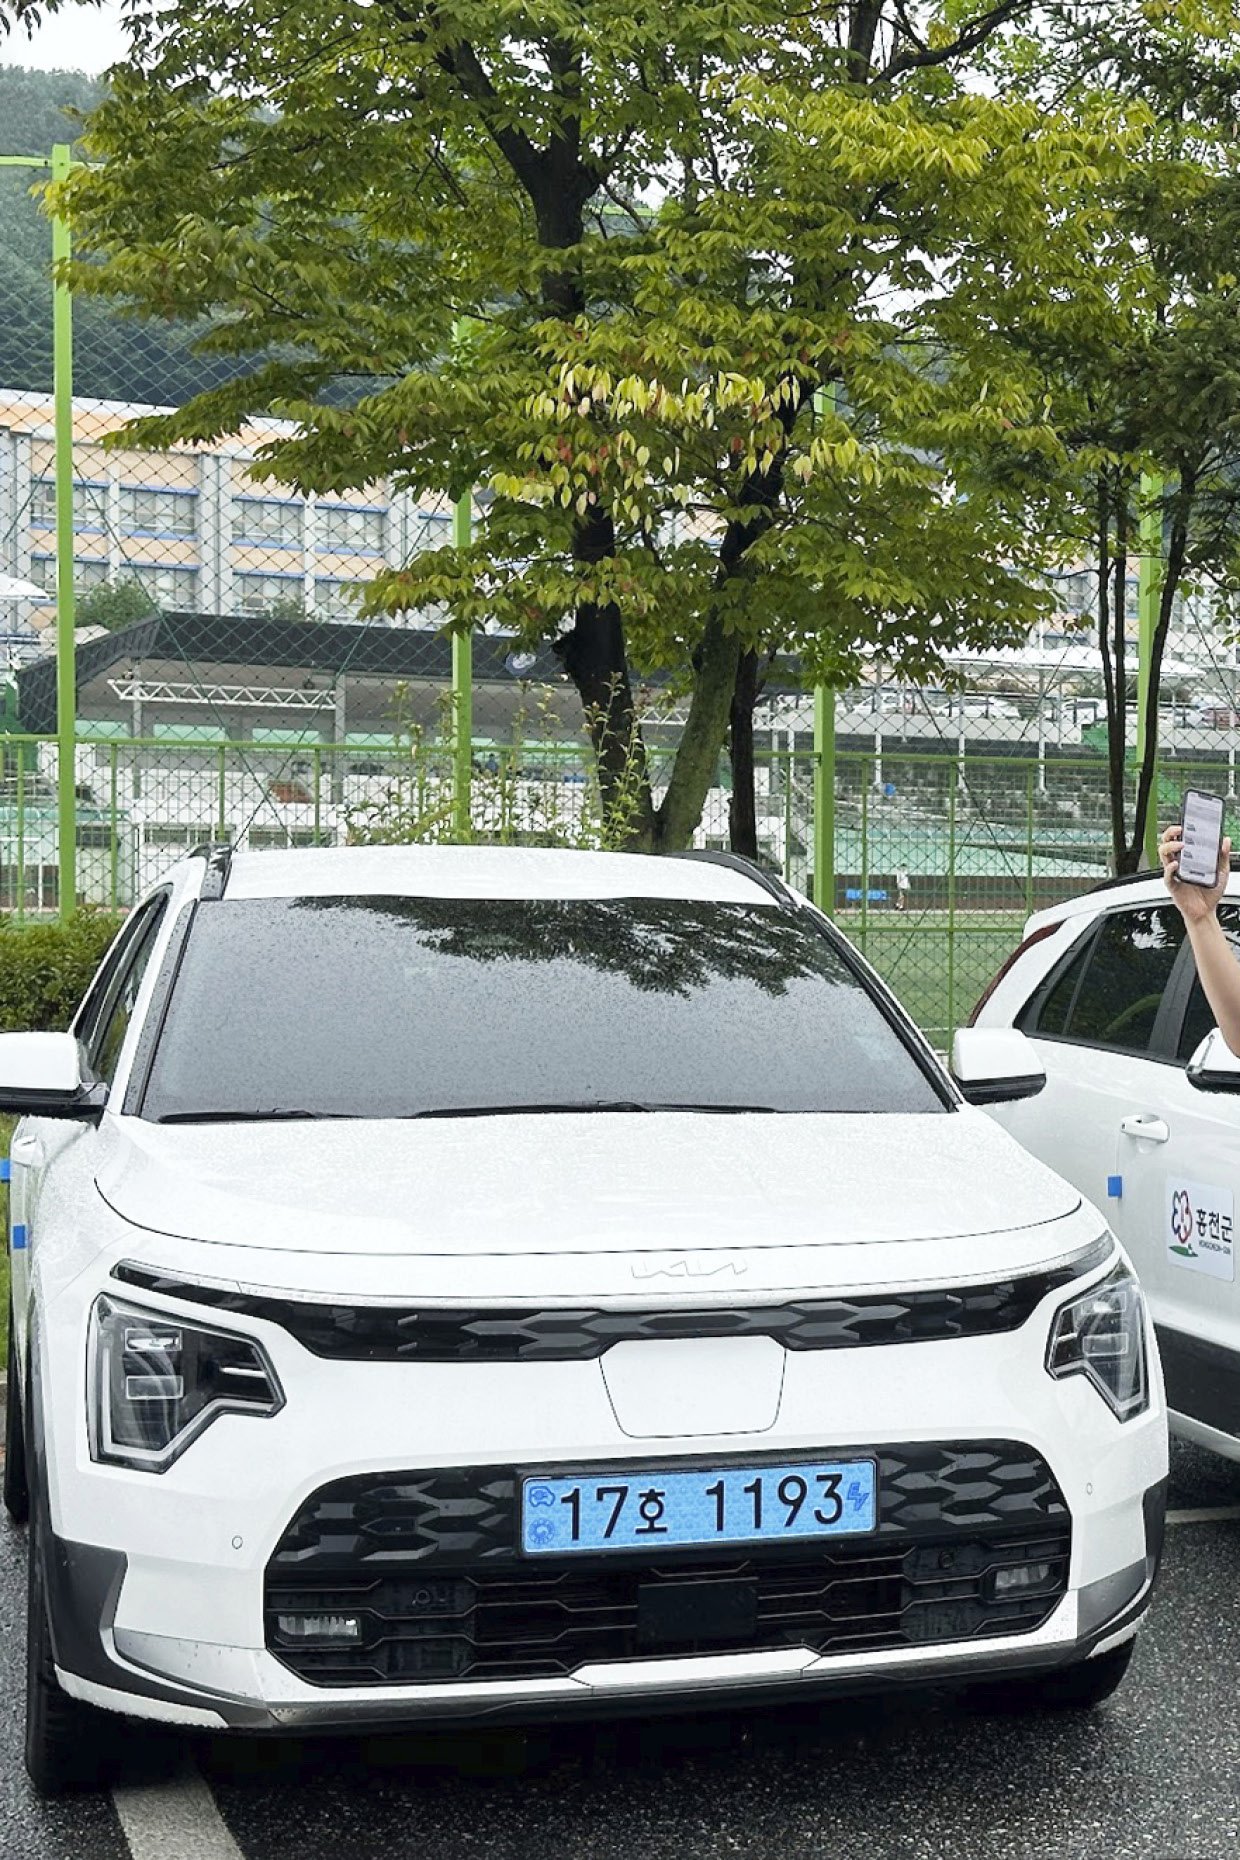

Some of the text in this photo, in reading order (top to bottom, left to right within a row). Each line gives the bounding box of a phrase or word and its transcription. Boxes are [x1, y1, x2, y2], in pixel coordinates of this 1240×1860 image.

[1195, 1208, 1233, 1243] 홍천군
[560, 1473, 844, 1541] 17호 1193
[847, 1481, 870, 1512] EV
